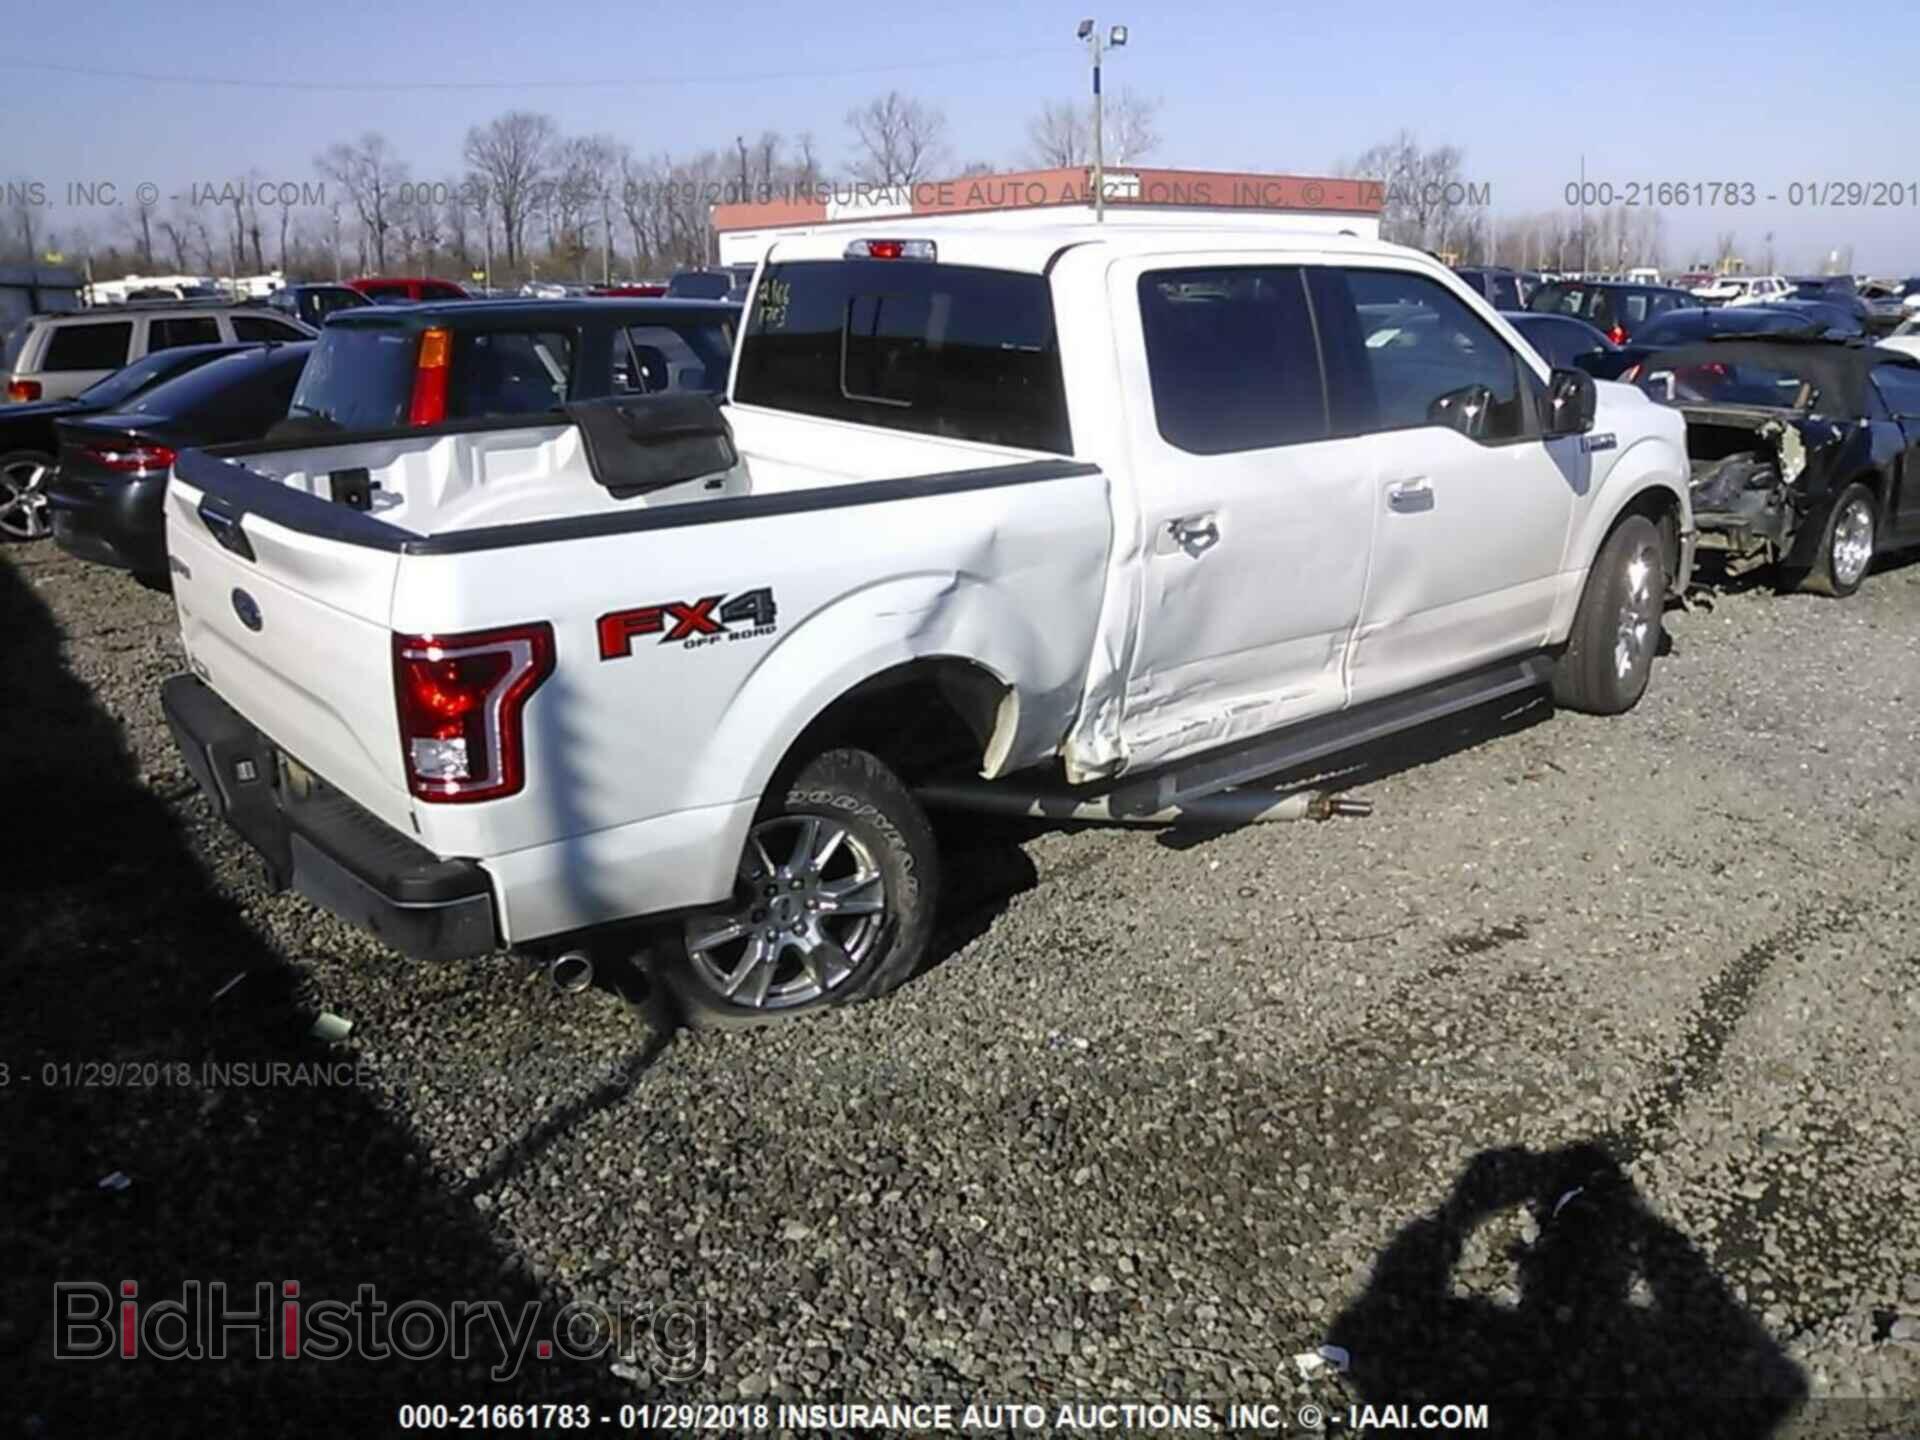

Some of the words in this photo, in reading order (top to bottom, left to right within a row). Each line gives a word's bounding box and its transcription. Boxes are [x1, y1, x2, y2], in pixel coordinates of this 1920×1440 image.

[595, 586, 777, 662] FX4
[683, 634, 722, 650] OFF
[728, 626, 777, 642] ROAD
